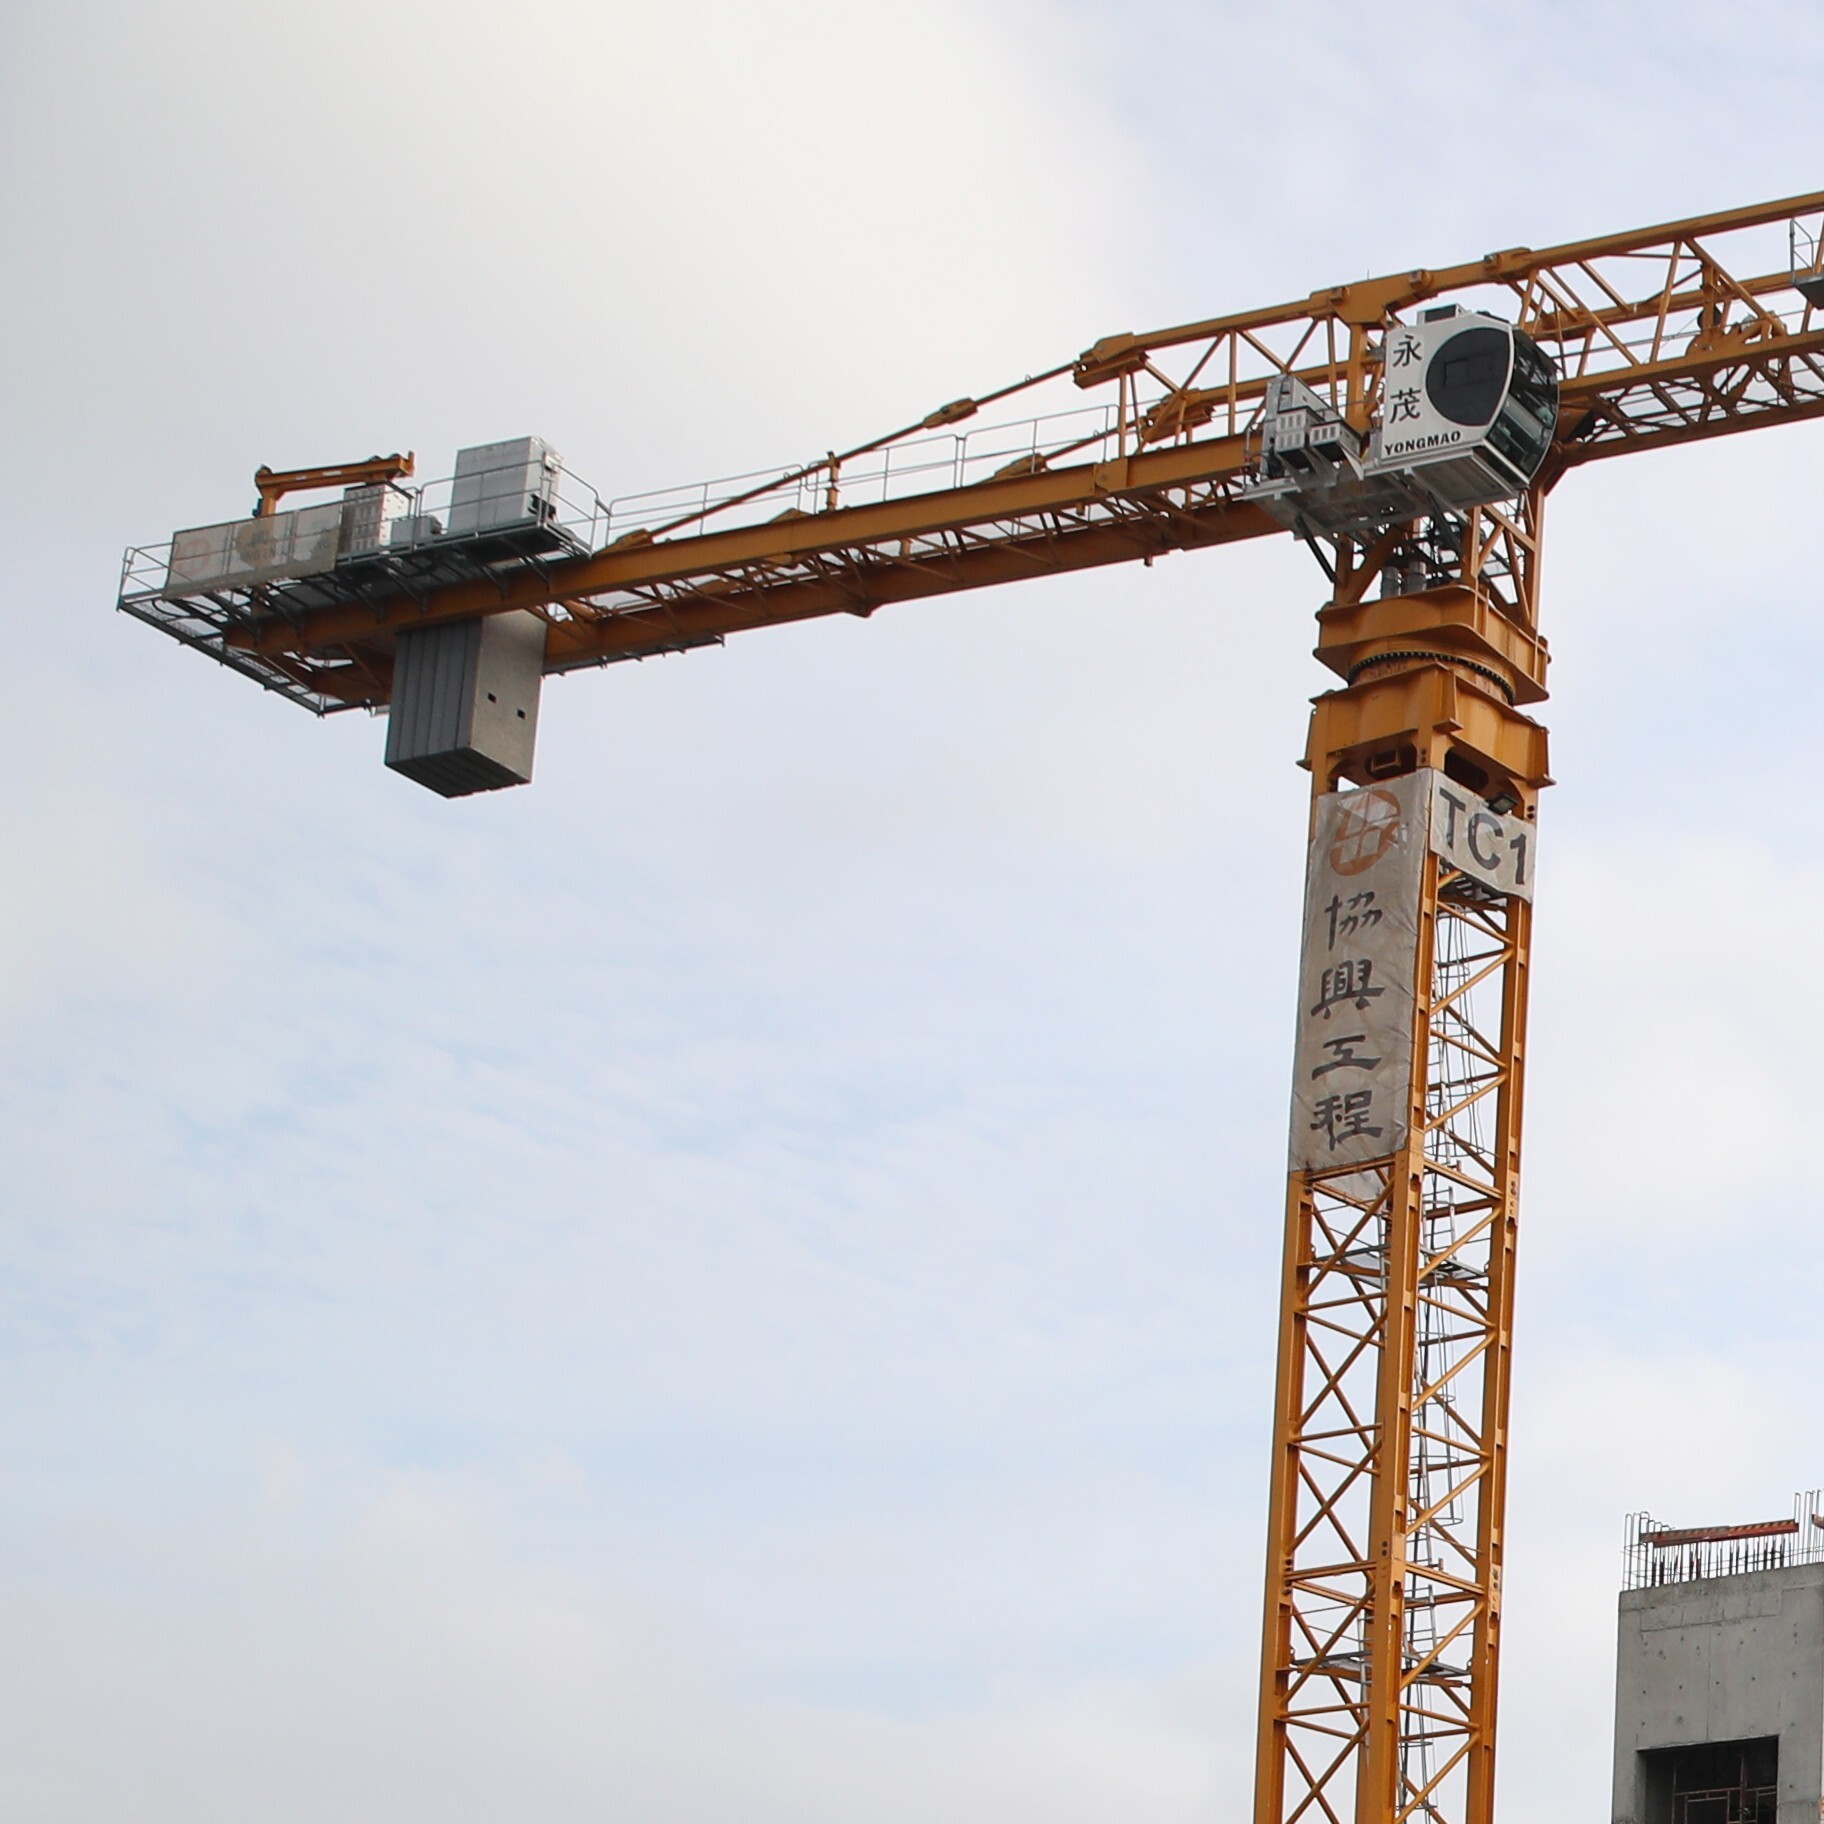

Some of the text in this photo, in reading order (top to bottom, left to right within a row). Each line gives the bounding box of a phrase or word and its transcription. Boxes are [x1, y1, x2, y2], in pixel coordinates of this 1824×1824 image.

[1389, 334, 1422, 424] 永茂
[1384, 430, 1461, 456] YONGMAO
[1439, 786, 1526, 885] TC1
[1311, 890, 1384, 1151] 協興工程
